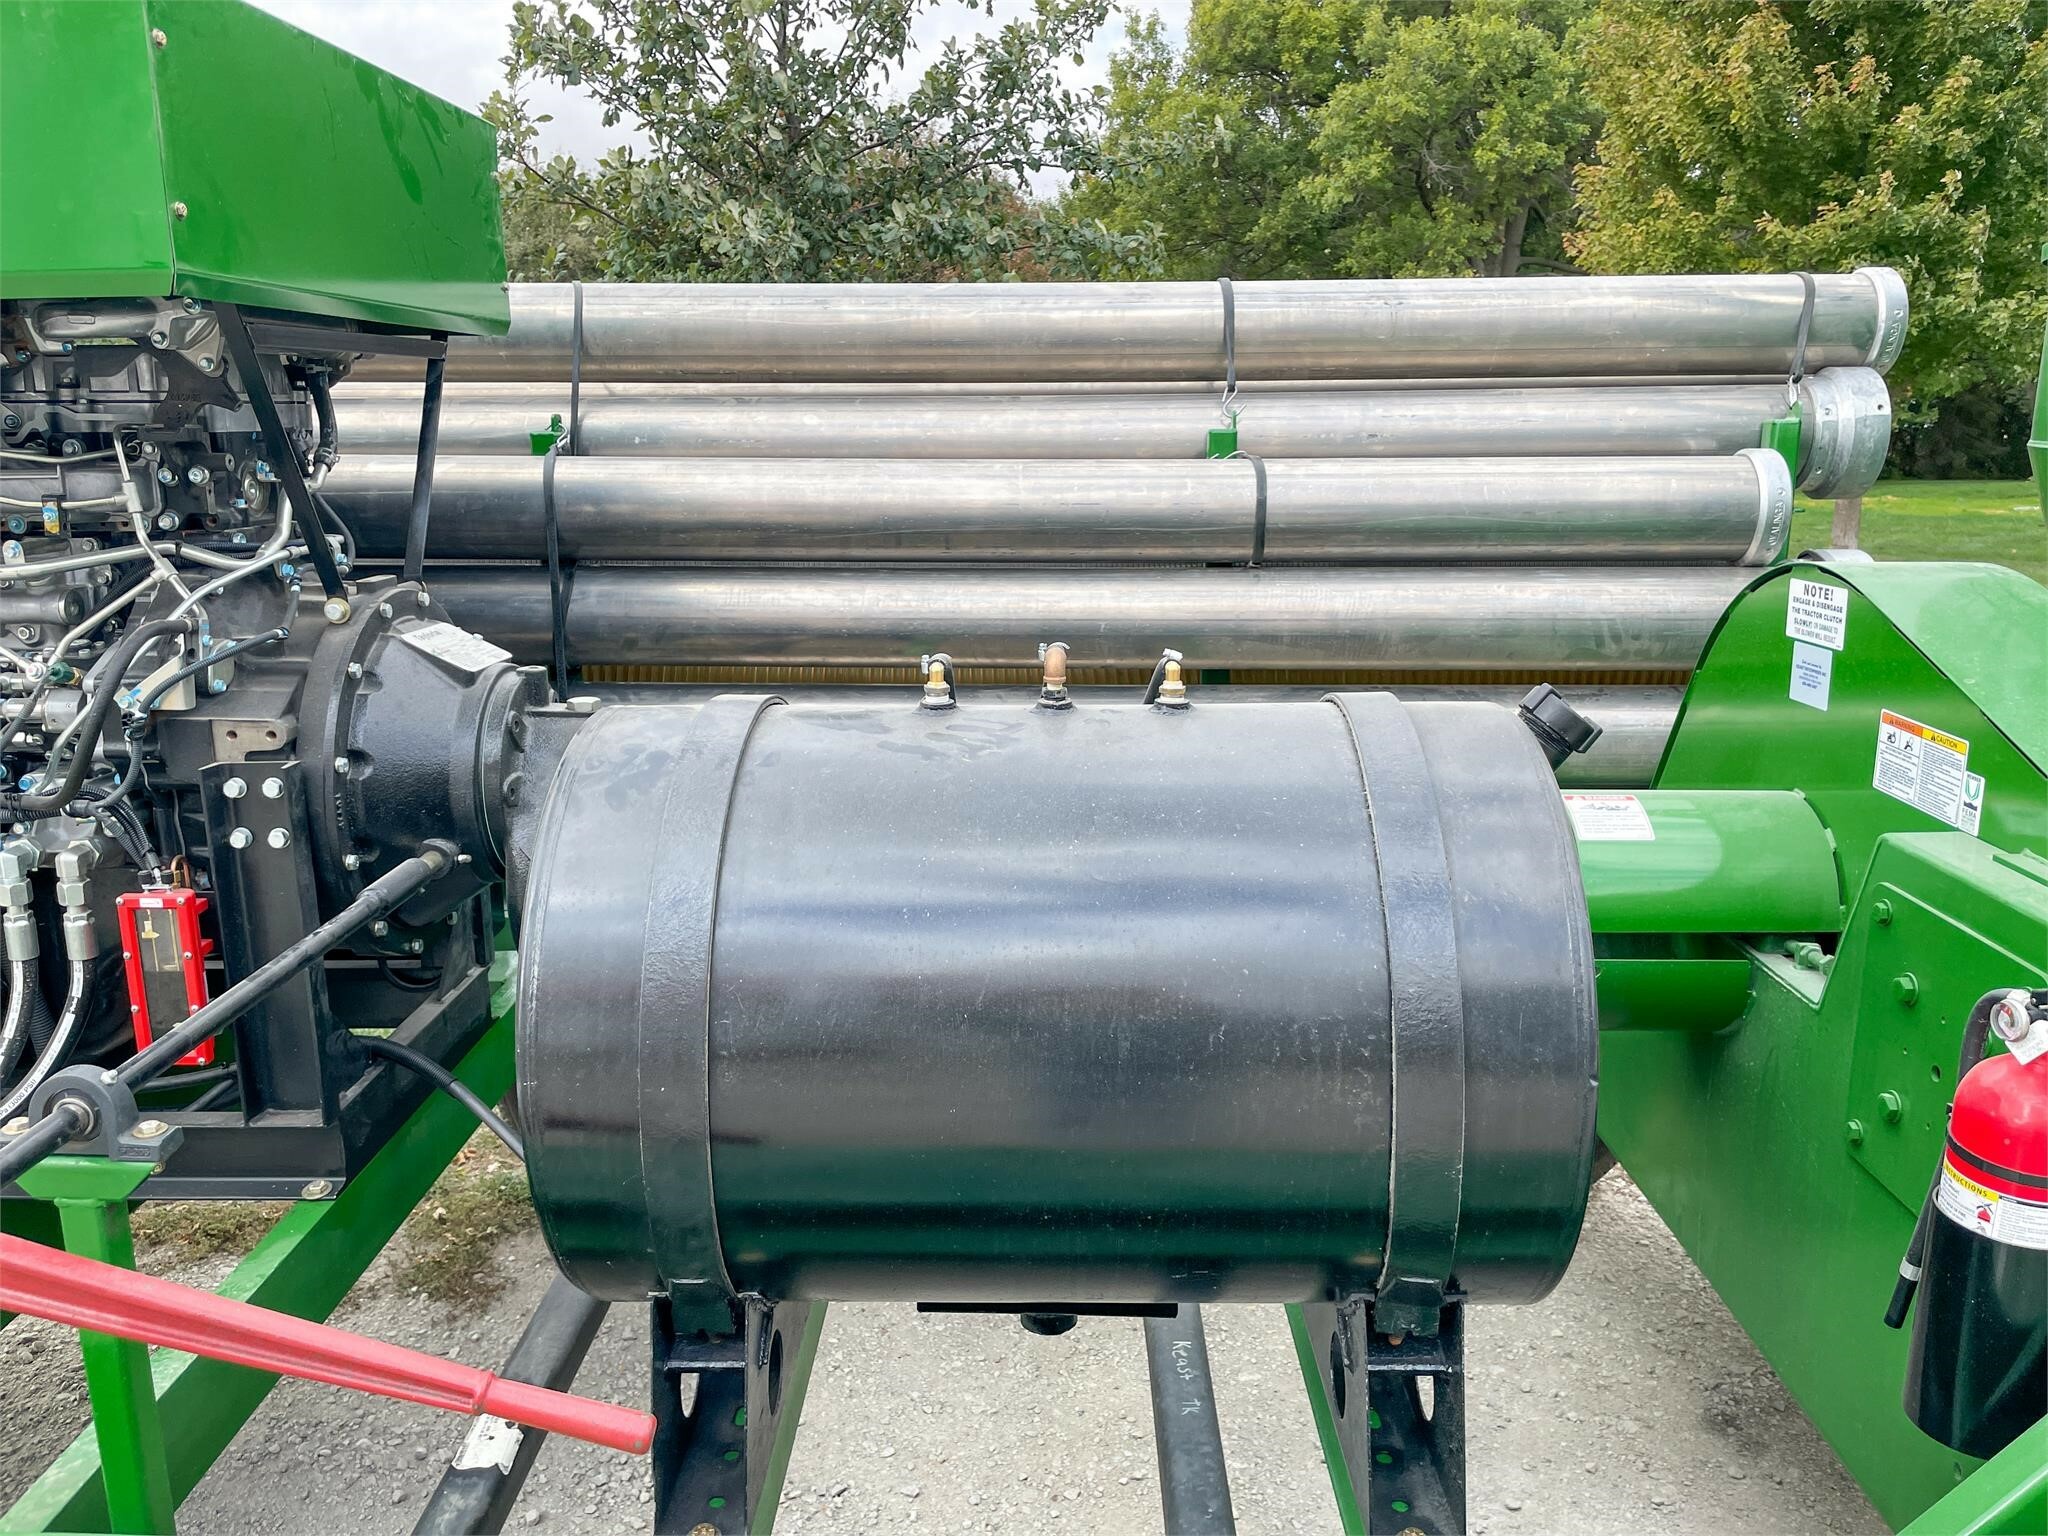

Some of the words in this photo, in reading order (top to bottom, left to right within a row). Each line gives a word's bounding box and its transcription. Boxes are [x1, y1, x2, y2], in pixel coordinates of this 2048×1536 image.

[1804, 584, 1833, 601] NOTE!
[1792, 606, 1801, 614] THE
[1802, 608, 1822, 619] TRACTOR
[1824, 614, 1842, 624] CLUTCH
[1817, 601, 1843, 613] DISENGAGE
[1935, 735, 1958, 749] CAUTION
[1171, 1341, 1194, 1381] Keast
